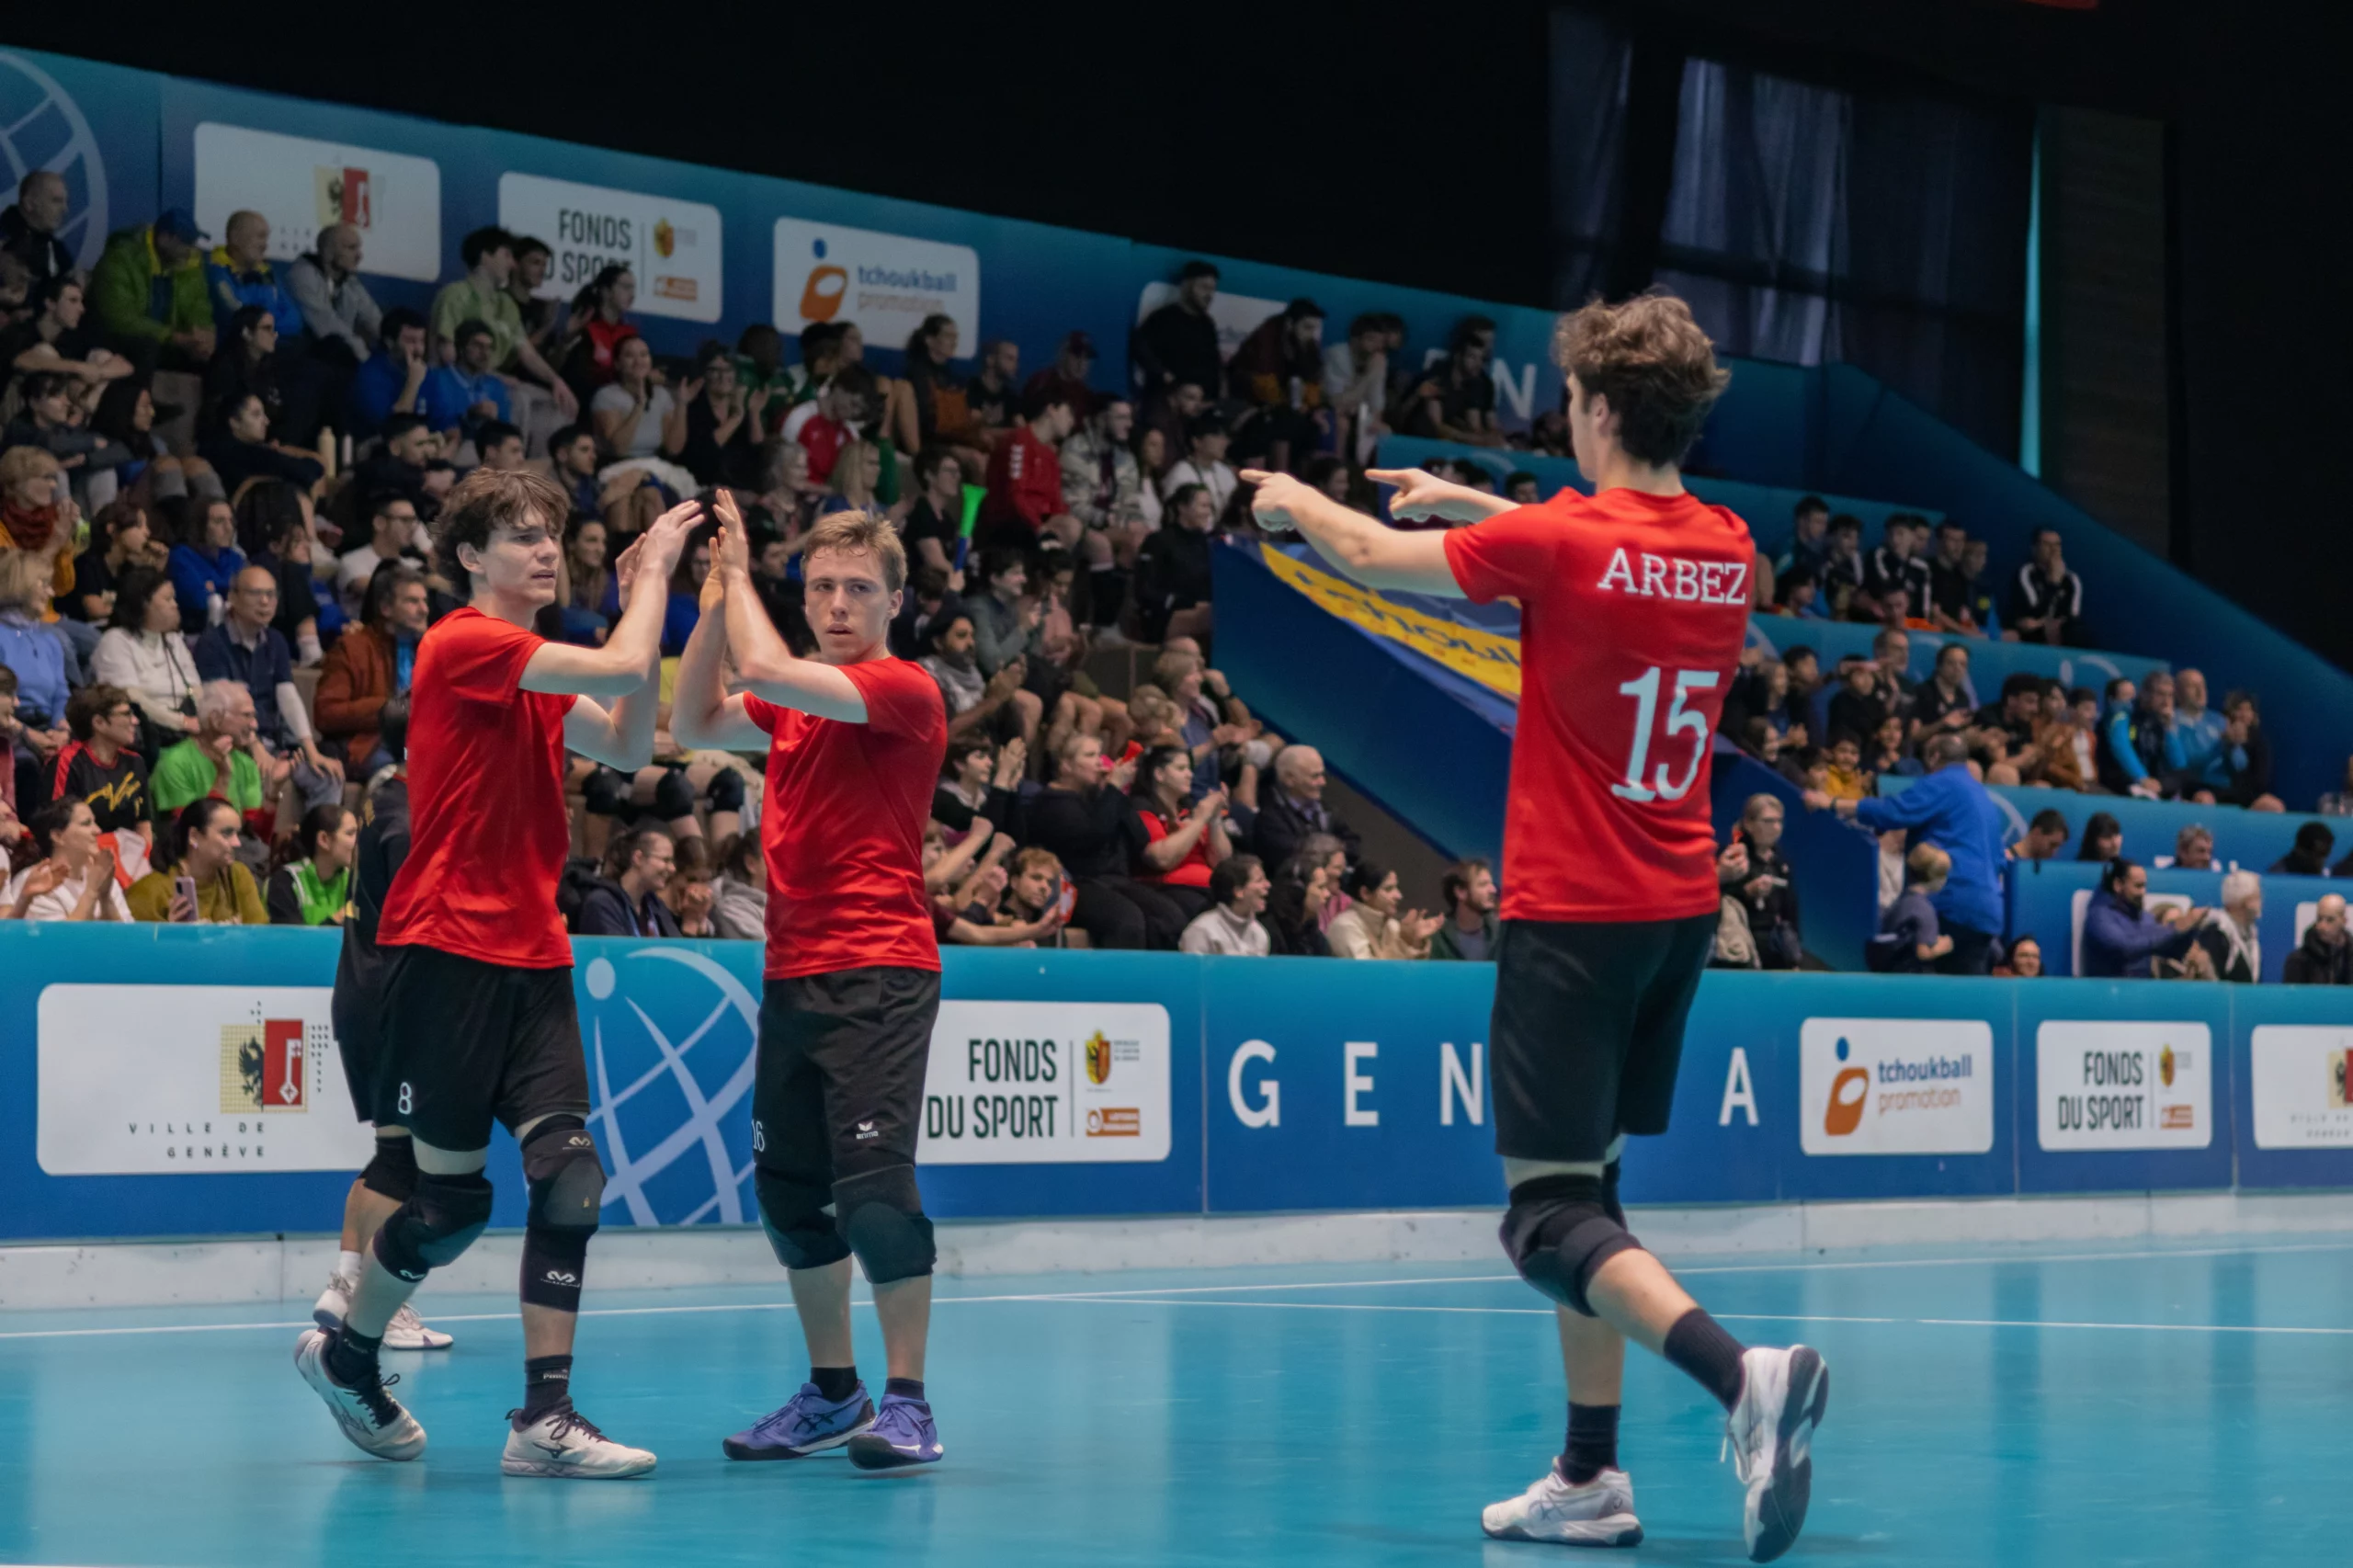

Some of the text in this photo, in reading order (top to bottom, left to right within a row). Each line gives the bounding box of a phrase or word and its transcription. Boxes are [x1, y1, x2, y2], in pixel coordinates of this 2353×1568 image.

[558, 208, 632, 251] FONDS
[562, 250, 632, 284] SPO
[1597, 547, 1747, 605] ARBEZ
[1610, 665, 1721, 802] 15
[968, 1038, 1057, 1082] FONDS
[1878, 1053, 1972, 1084] tchoukball
[2083, 1050, 2144, 1086] FONDS
[397, 1082, 413, 1114] 8
[1227, 1039, 1760, 1129] GENA
[926, 1094, 964, 1139] DU
[972, 1094, 1059, 1139] SPORT
[1878, 1088, 1961, 1117] promotion
[2057, 1095, 2083, 1131] DU
[2086, 1095, 2144, 1131] SPORT
[129, 1122, 265, 1134] VILLE DE
[166, 1142, 265, 1159] GENÈVE
